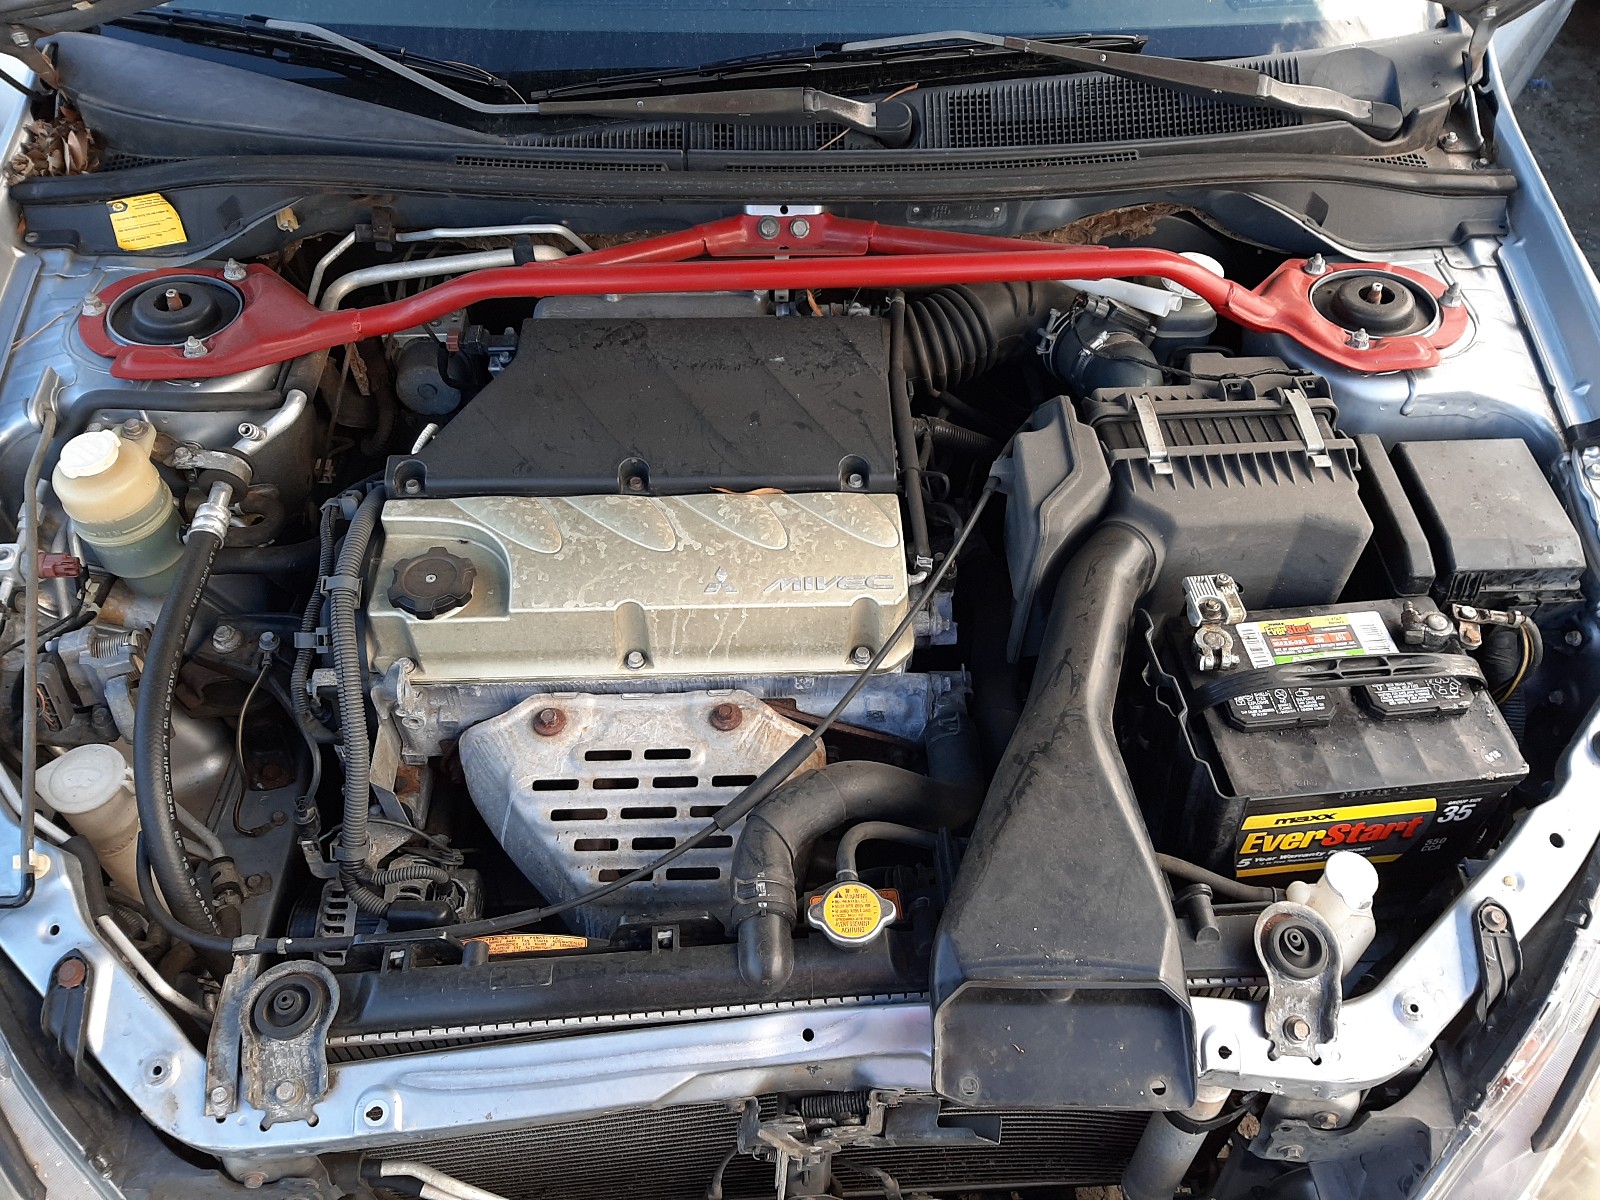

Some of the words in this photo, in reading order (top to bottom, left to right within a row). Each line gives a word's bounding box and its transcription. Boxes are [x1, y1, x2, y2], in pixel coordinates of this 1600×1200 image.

[763, 574, 894, 593] MIVEC
[1265, 622, 1312, 636] EverStart
[1274, 812, 1338, 826] maxx
[1437, 804, 1477, 824] 35
[1239, 816, 1425, 855] EverStart
[1425, 837, 1448, 846] 550
[1420, 844, 1442, 852] CCA
[1236, 858, 1253, 868] 5
[1280, 850, 1327, 860] Warranty
